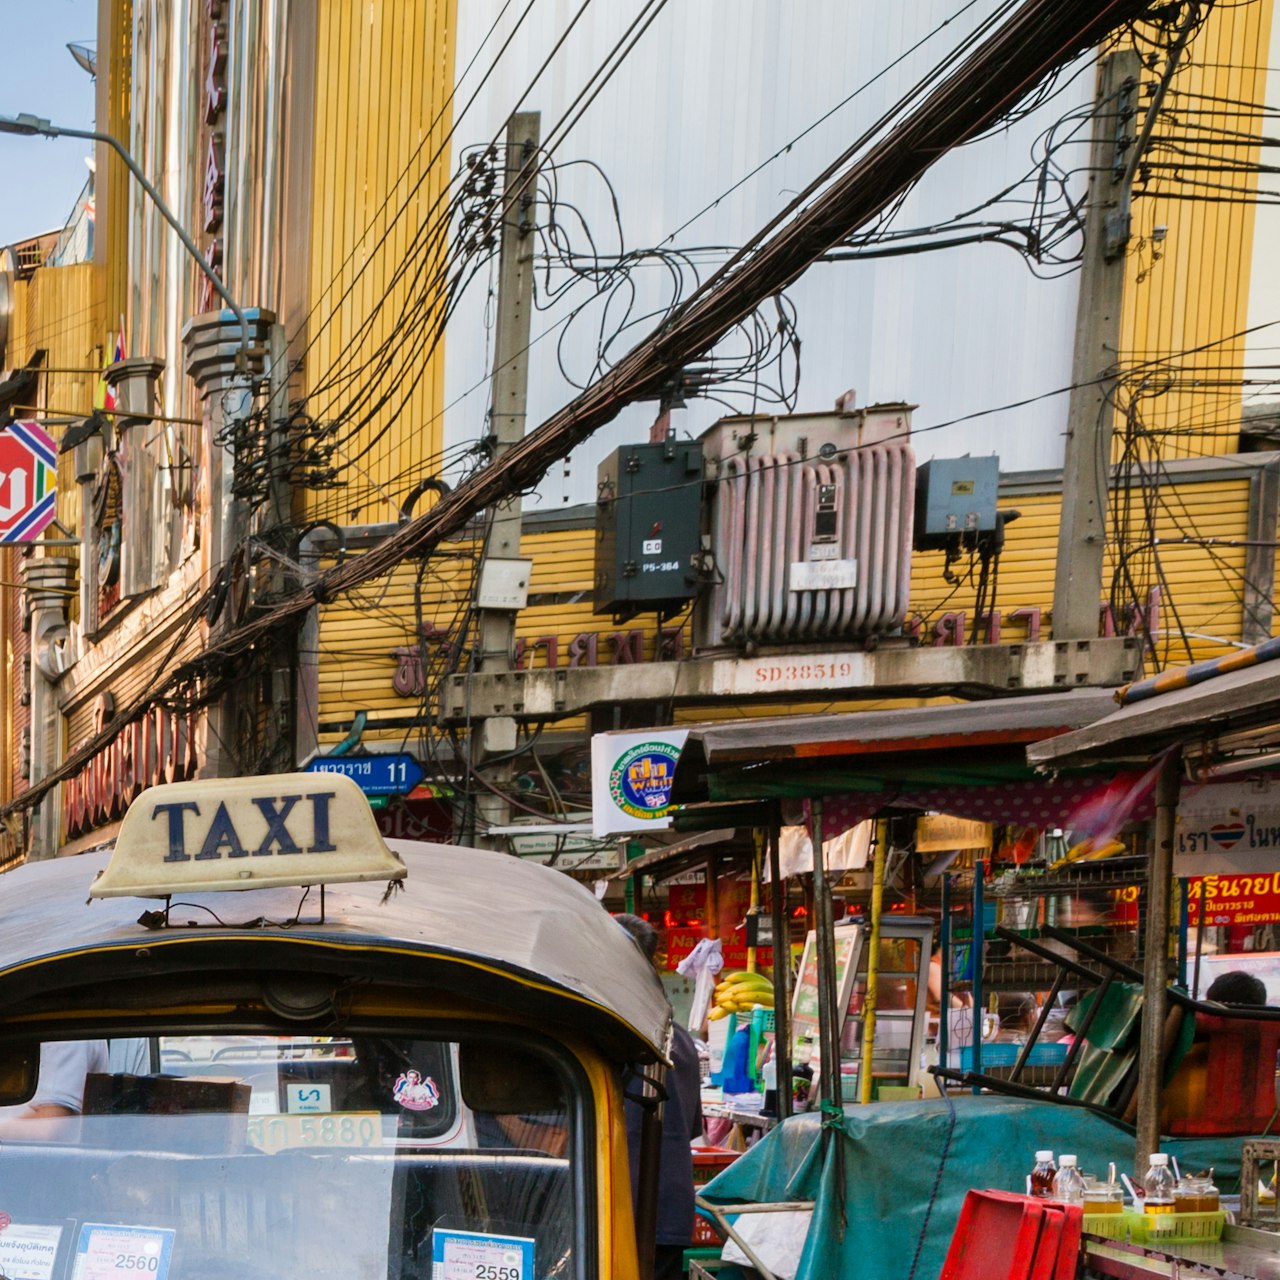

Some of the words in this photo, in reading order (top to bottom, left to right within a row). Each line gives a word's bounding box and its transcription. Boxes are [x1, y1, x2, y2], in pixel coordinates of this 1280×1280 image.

[756, 666, 782, 683] SD
[786, 663, 852, 681] 38519
[387, 762, 406, 783] 11
[152, 792, 337, 863] TAXI
[1179, 831, 1208, 852] เรา
[114, 1254, 159, 1271] 2560
